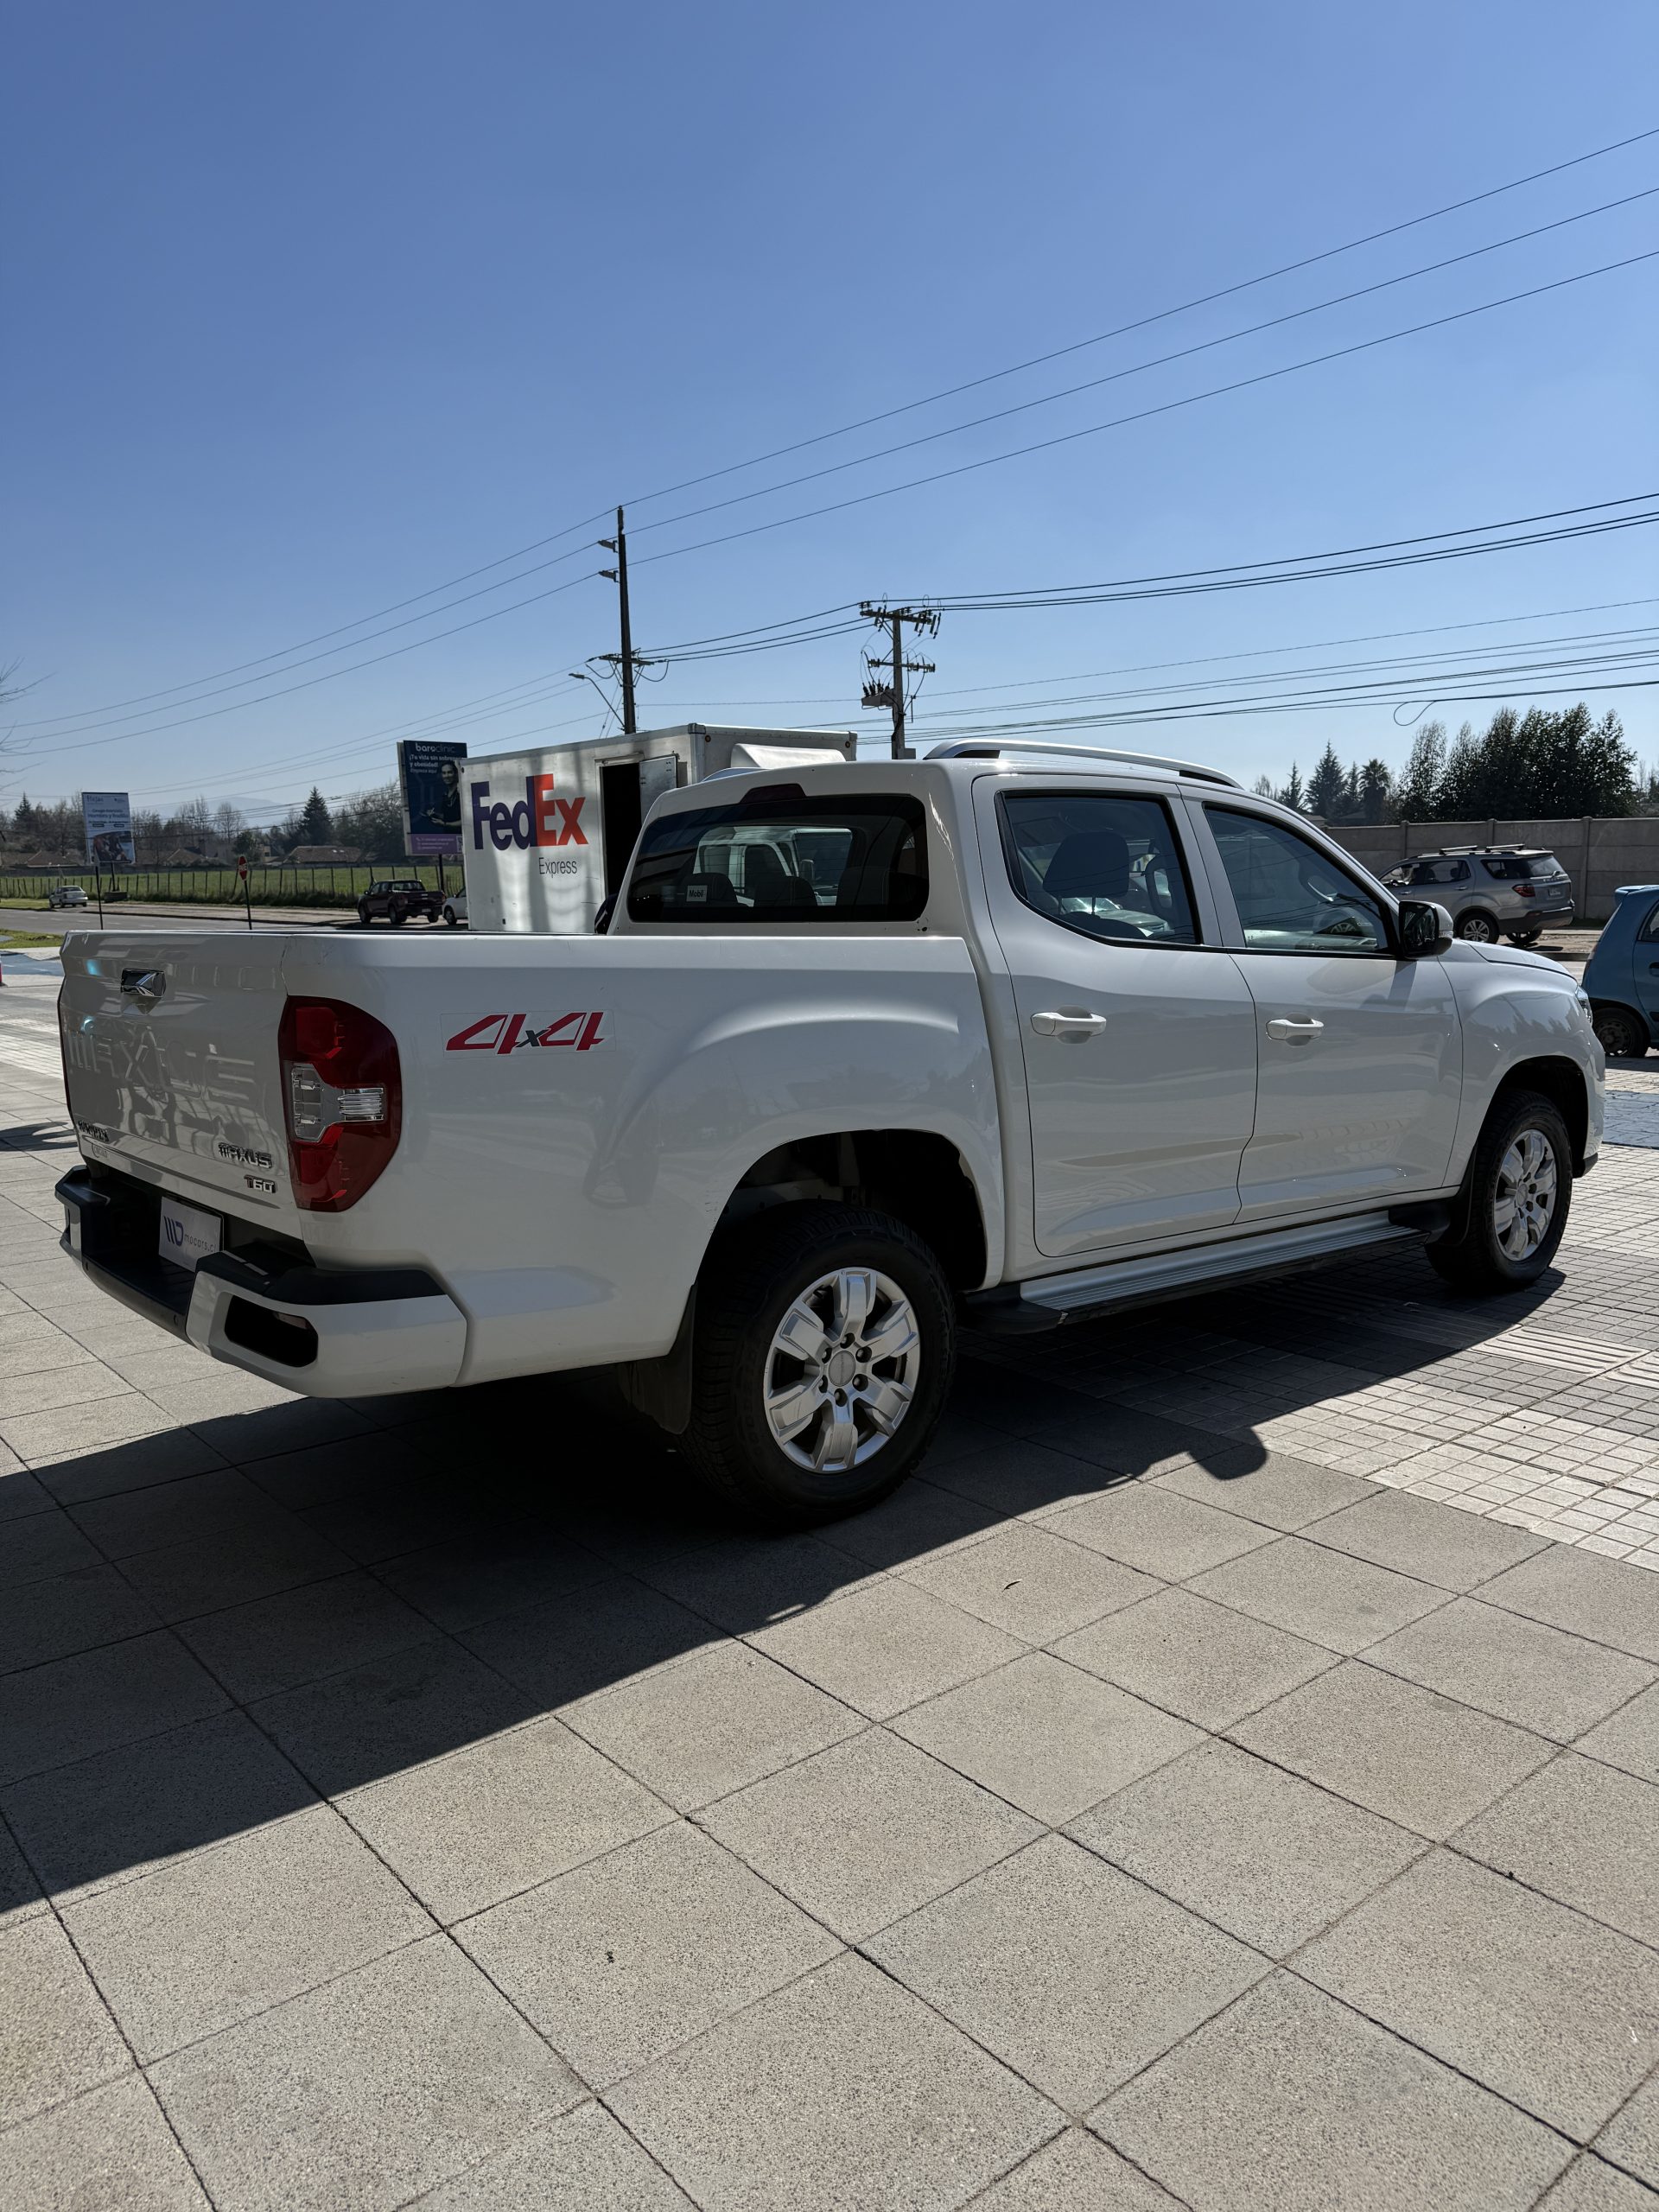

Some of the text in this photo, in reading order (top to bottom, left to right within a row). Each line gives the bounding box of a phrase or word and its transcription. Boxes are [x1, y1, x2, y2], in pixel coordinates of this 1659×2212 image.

[471, 773, 588, 850] FedEx
[539, 857, 578, 878] Express
[446, 1012, 605, 1055] 4x4
[218, 1142, 273, 1169] MAXUS
[244, 1174, 276, 1193] T60
[184, 1233, 217, 1253] mocars.cl
